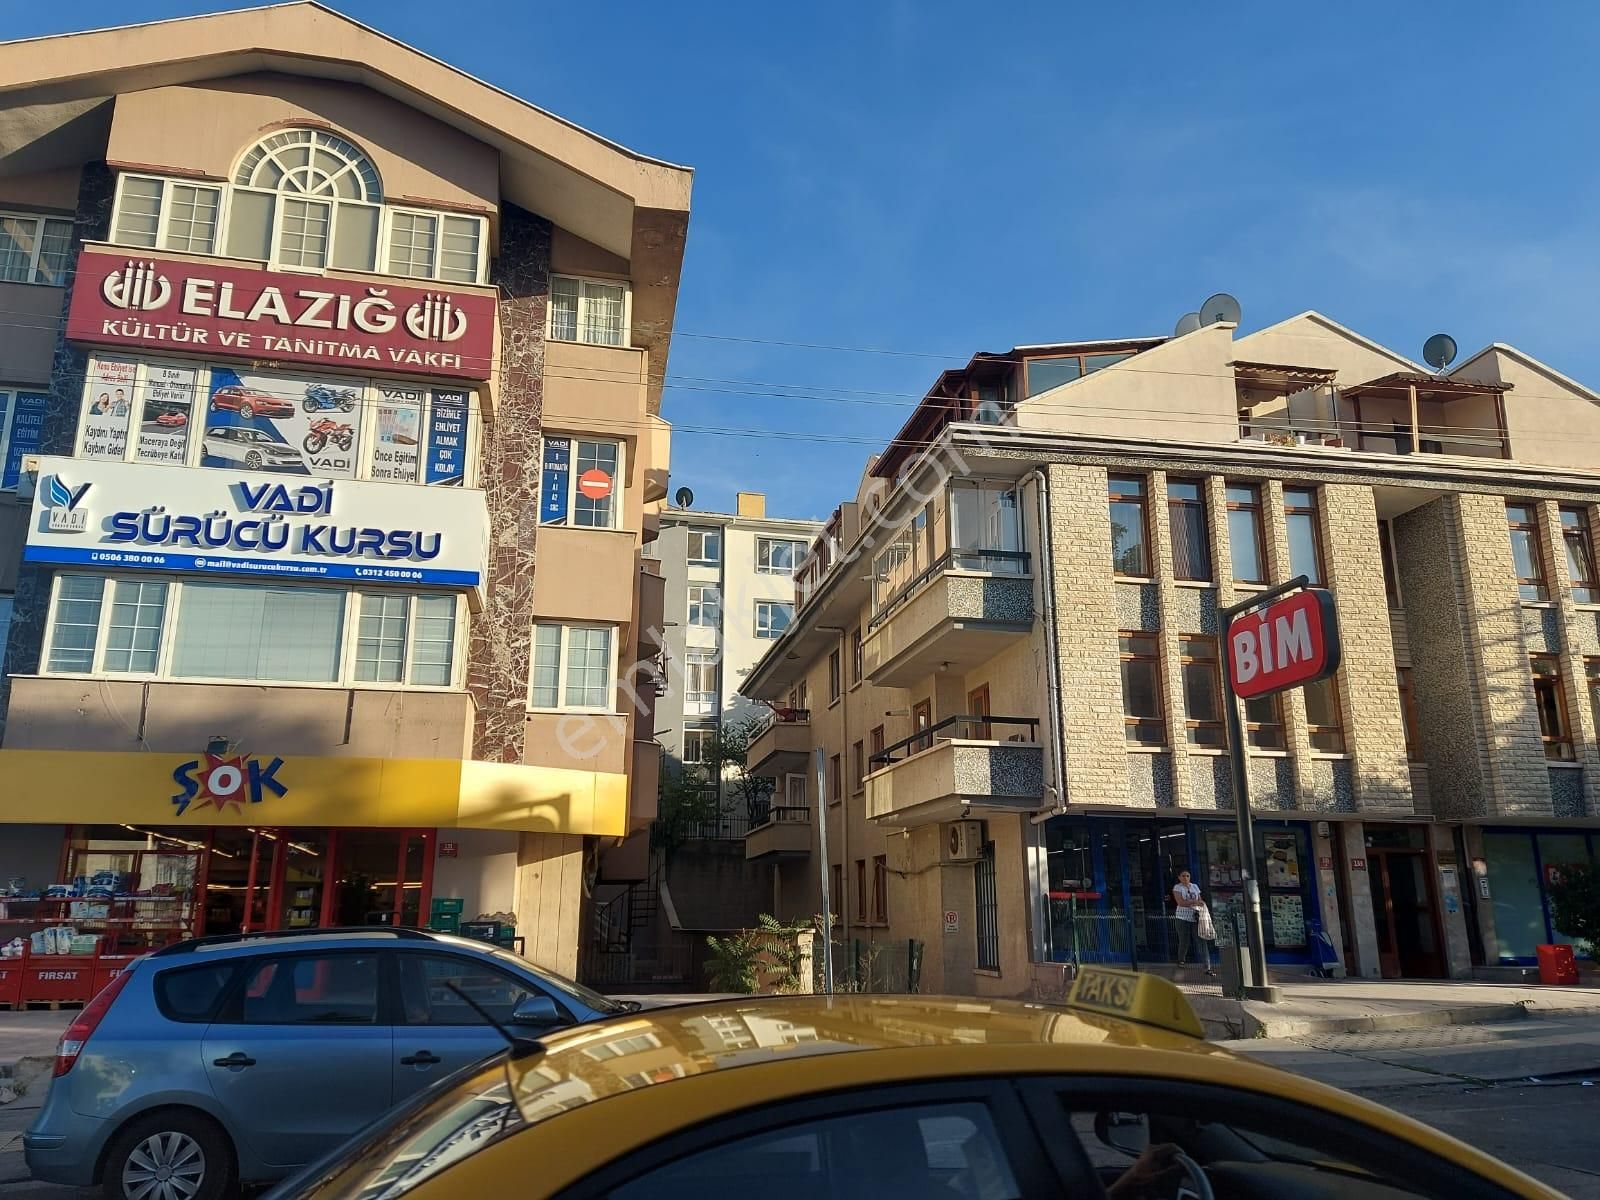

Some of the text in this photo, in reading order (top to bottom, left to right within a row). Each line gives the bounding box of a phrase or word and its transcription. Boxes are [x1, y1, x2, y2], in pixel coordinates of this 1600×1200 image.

[182, 277, 397, 334] ELAZIĞ
[102, 316, 462, 370] KÜLTÜR VE TANITMA VAKFI
[435, 420, 461, 433] EHLİYET
[139, 435, 168, 448] Maceraya
[435, 435, 458, 447] ALMAK
[374, 447, 417, 466] Önce Eğitim
[439, 449, 453, 460] ÇOK
[371, 465, 391, 479] Sonra
[434, 462, 455, 473] KOLAY
[239, 479, 334, 514] VADİ
[109, 505, 290, 550] SÜRÜCÜ
[302, 523, 442, 559] KURSU
[99, 552, 165, 564] 0506 380 00 06
[362, 568, 423, 579] 0312 450 00 06
[1232, 607, 1313, 684] BİM
[172, 756, 289, 816] ŞOK
[38, 971, 78, 981] FIRSAT
